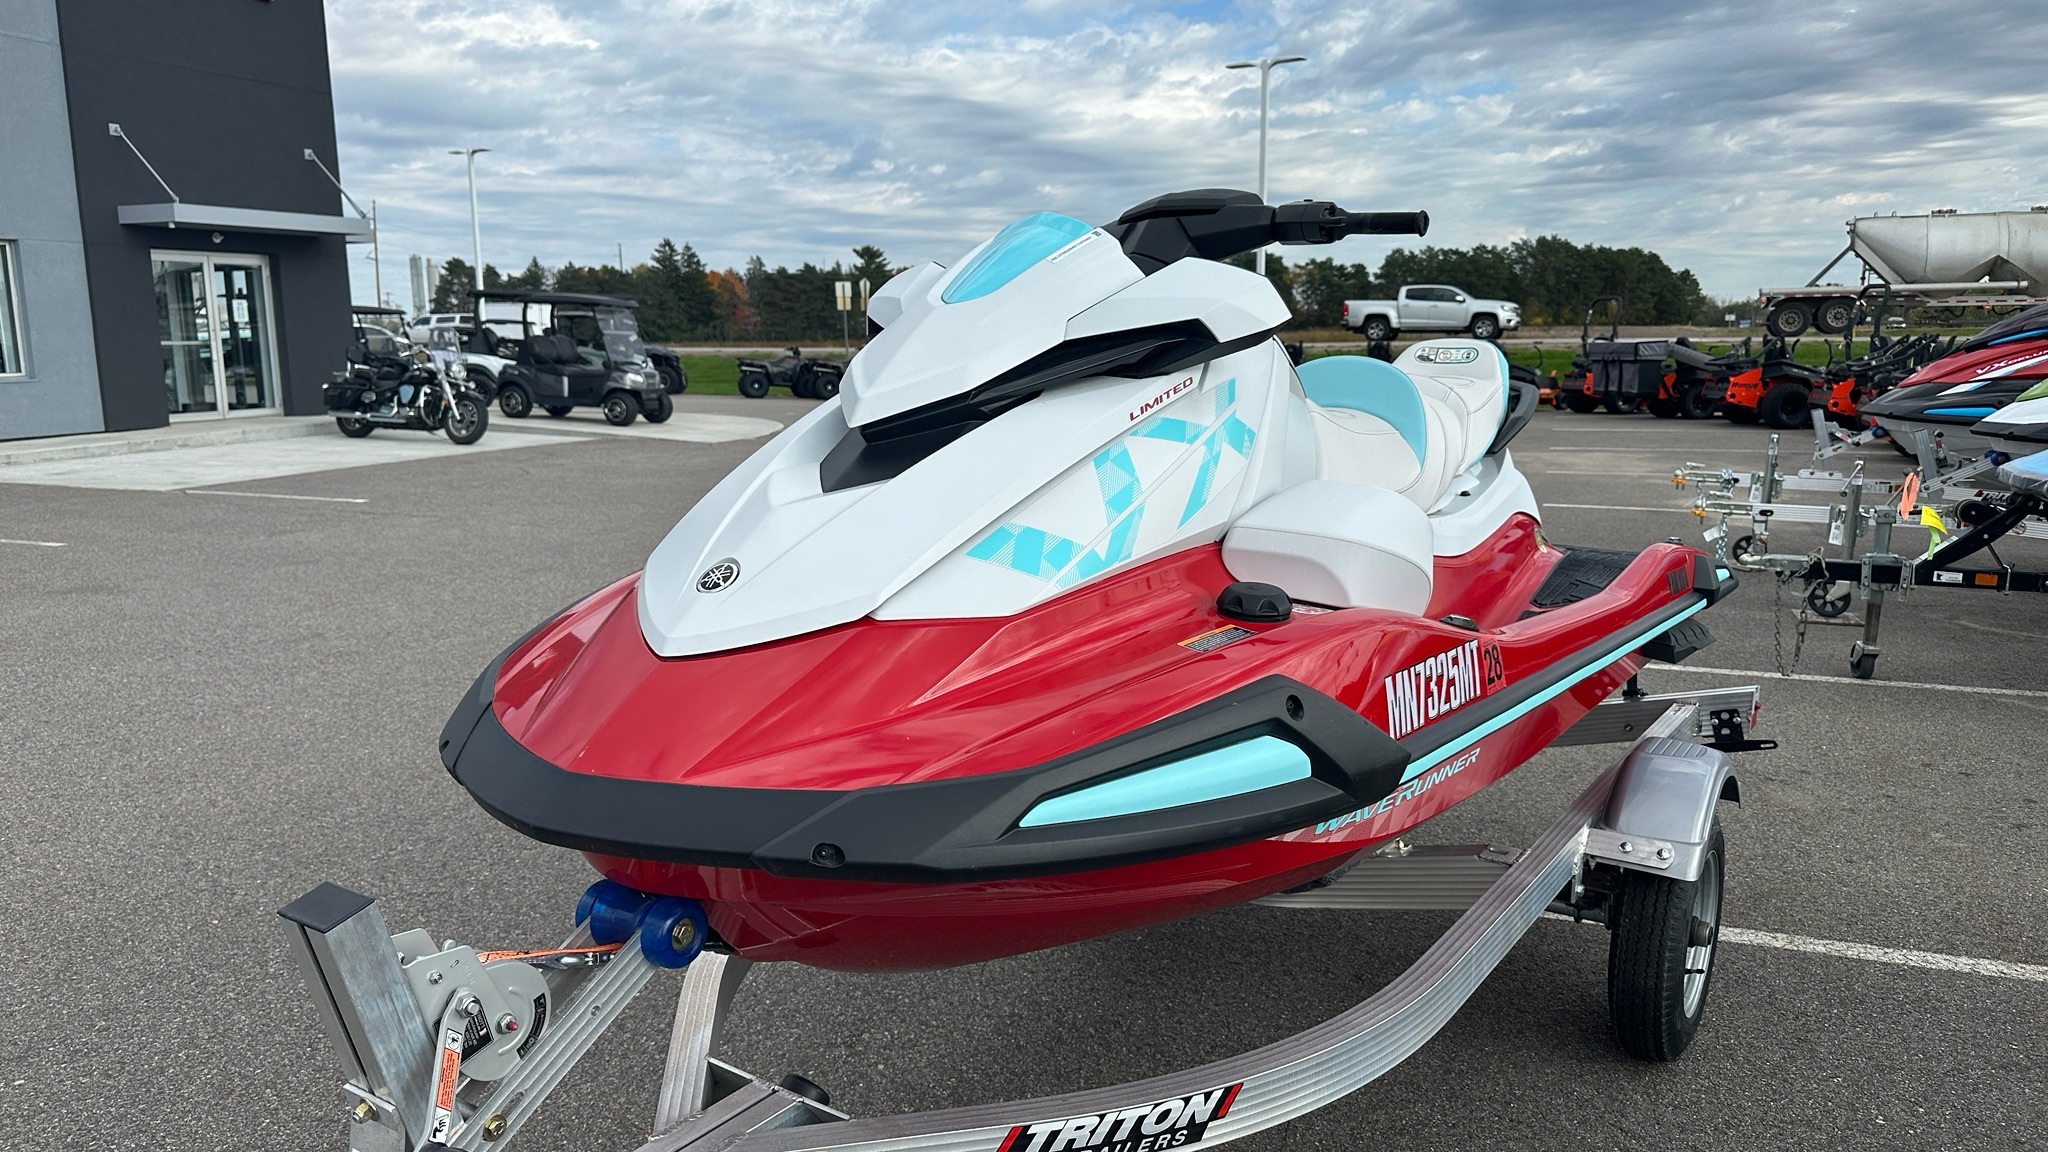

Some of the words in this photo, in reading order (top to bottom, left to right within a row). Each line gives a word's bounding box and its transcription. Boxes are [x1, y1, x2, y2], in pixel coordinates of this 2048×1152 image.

[1129, 376, 1194, 422] LIMITED
[1980, 491, 2010, 501] TRIT
[1384, 639, 1481, 741] MN7325MT
[1484, 644, 1503, 684] 28
[1025, 1087, 1225, 1152] TRITON
